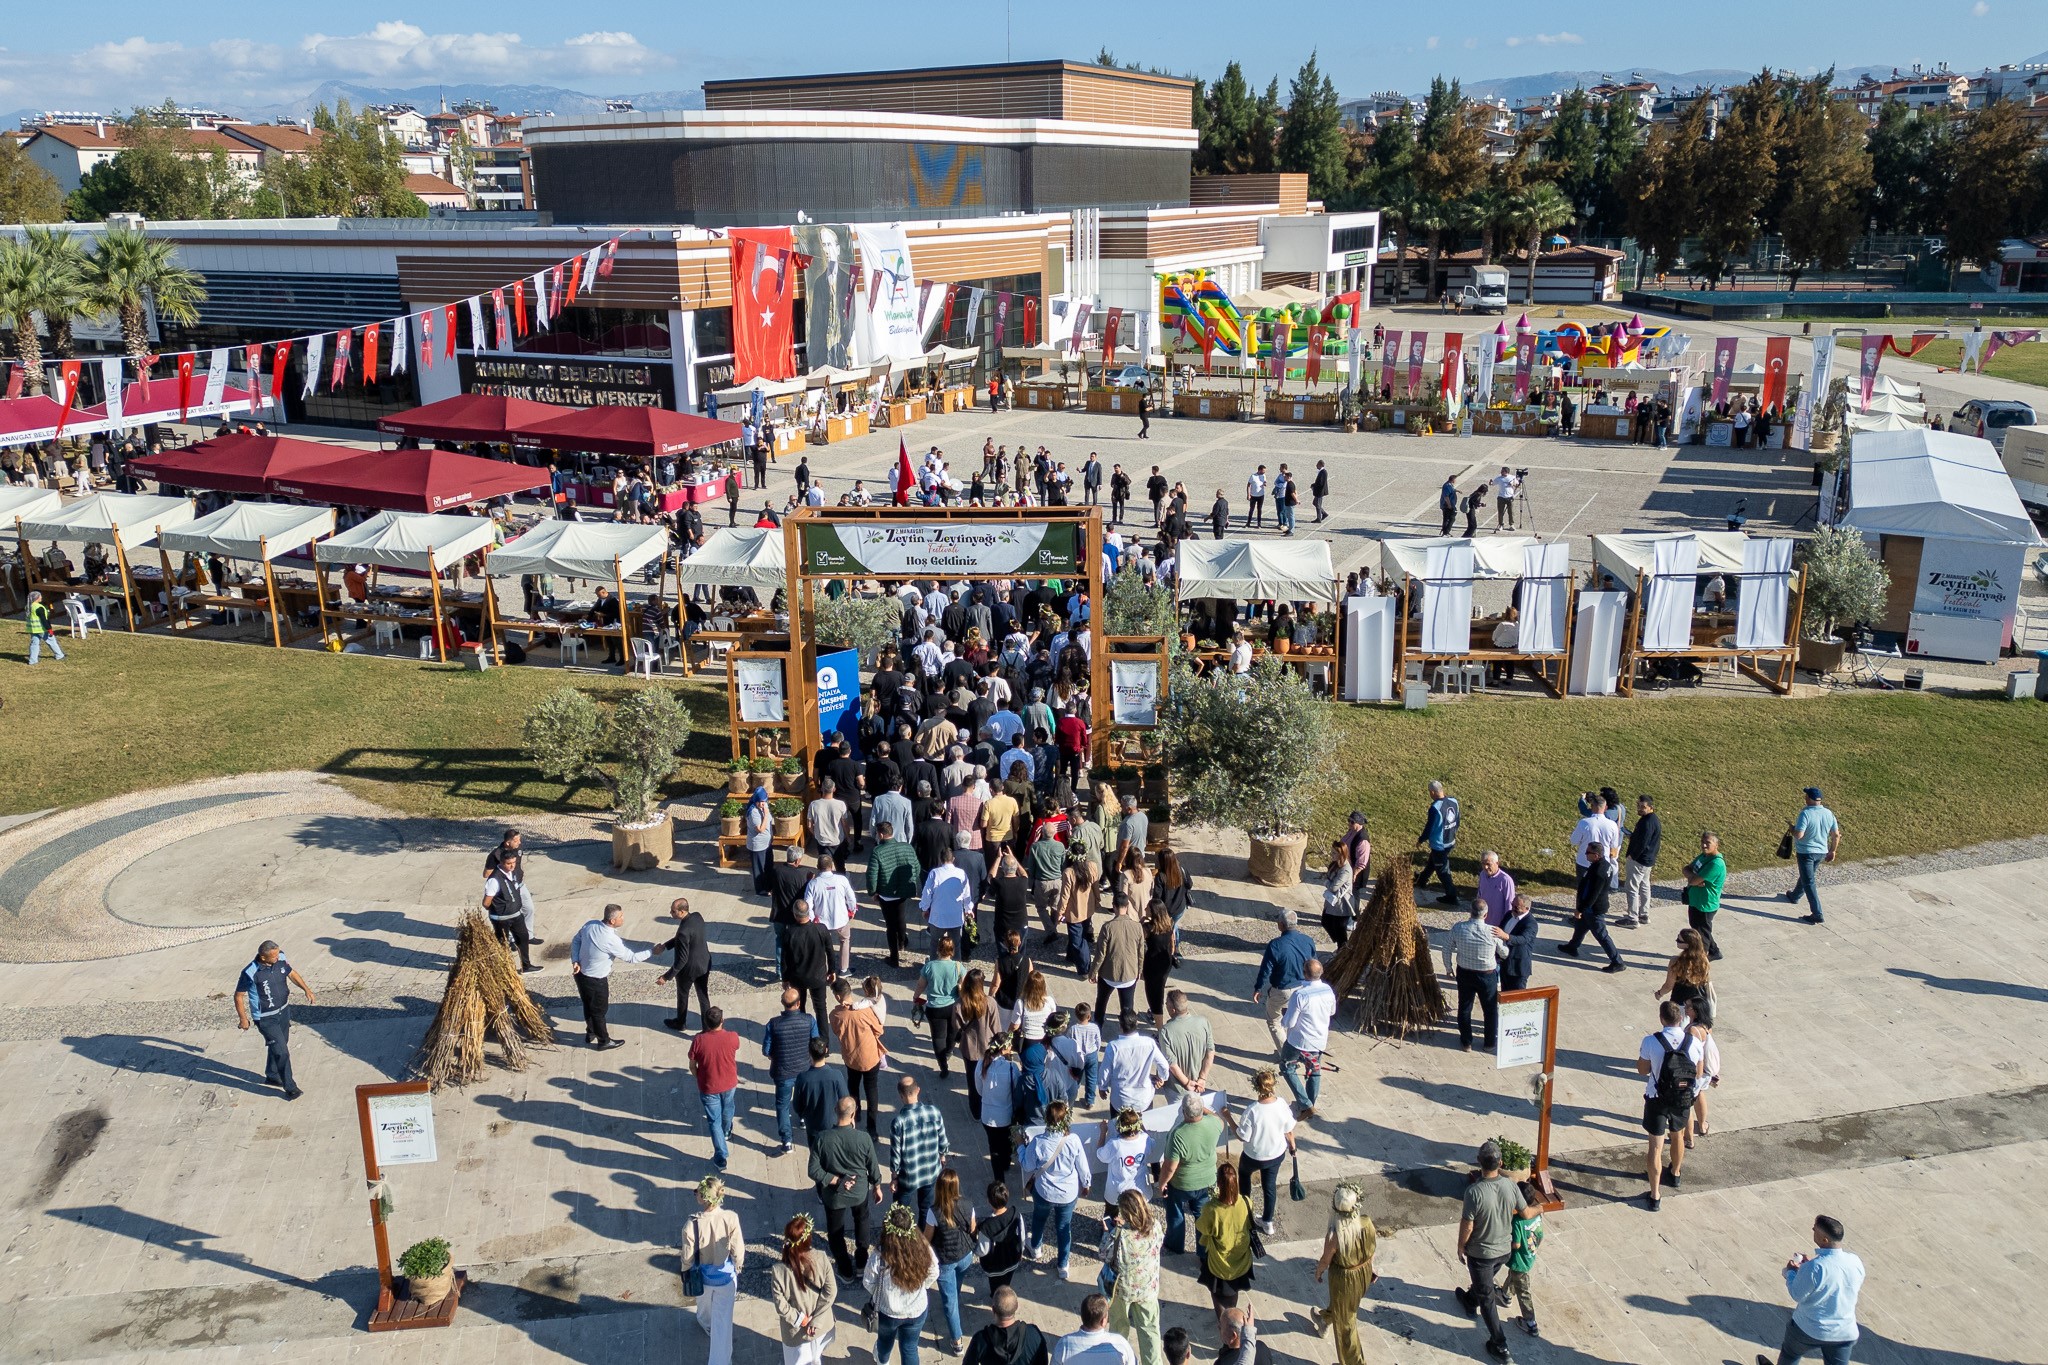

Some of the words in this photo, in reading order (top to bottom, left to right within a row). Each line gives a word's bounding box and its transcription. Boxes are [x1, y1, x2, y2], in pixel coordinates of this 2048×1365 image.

[475, 361, 556, 380] MANAVGAT
[559, 364, 652, 386] BELEDİYESİ
[471, 381, 533, 401] ATATÜRK
[535, 384, 594, 405] KÜLTÜR
[595, 389, 664, 409] MERKEZİ
[0, 433, 32, 442] ANAVGAT
[885, 528, 925, 547] Zeytin
[933, 528, 996, 547] Zeytinyağı
[906, 556, 928, 567] Hoş
[930, 555, 977, 566] Geldiniz
[1928, 572, 1977, 592] Zeytin
[1953, 588, 2007, 604] Zeytinyağı
[819, 693, 848, 706] ÜKŞEHİR
[820, 701, 845, 713] LEDİYESİ
